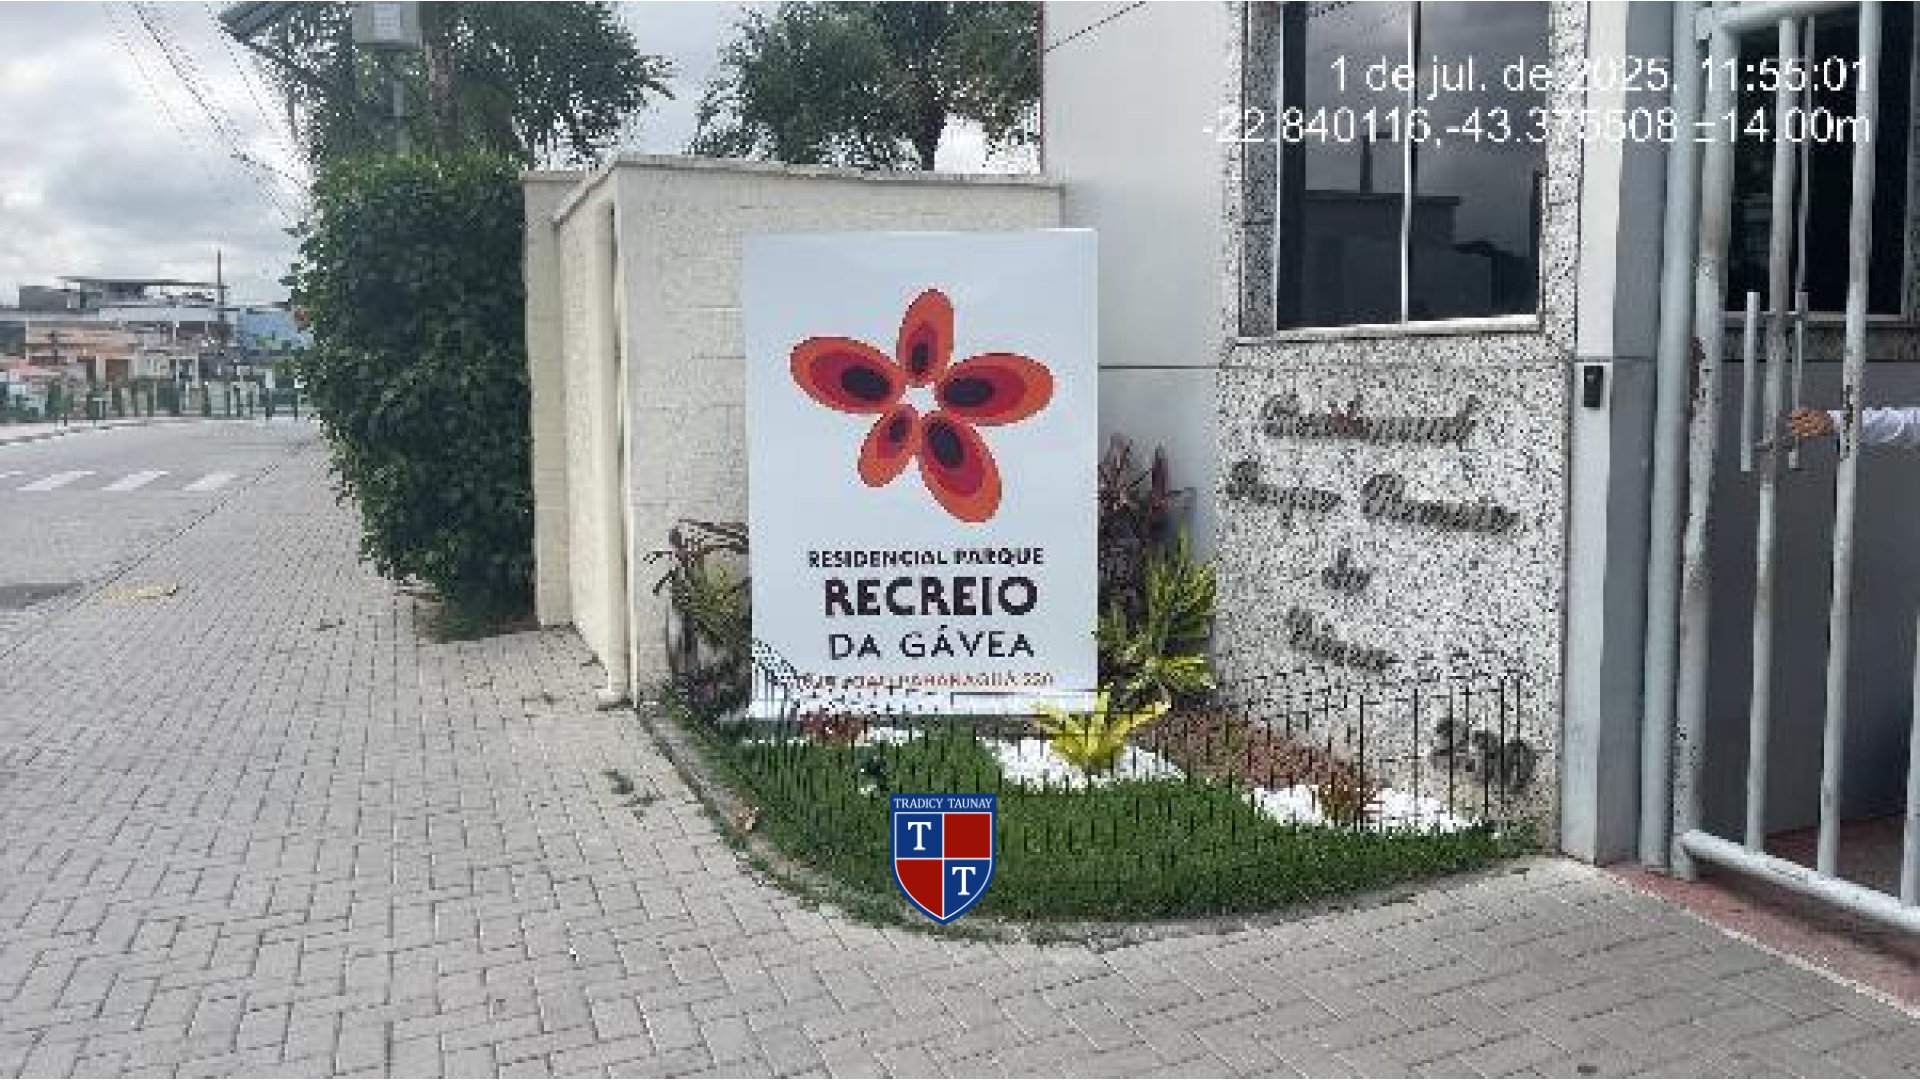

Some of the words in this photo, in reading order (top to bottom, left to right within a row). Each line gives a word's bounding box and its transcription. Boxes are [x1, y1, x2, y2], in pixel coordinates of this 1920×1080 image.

[808, 550, 948, 568] RESIDENCIAL
[952, 547, 1044, 567] PARQUE
[824, 576, 1038, 617] RECREIO
[828, 632, 882, 660] DA
[899, 624, 1035, 659] GÁVEA
